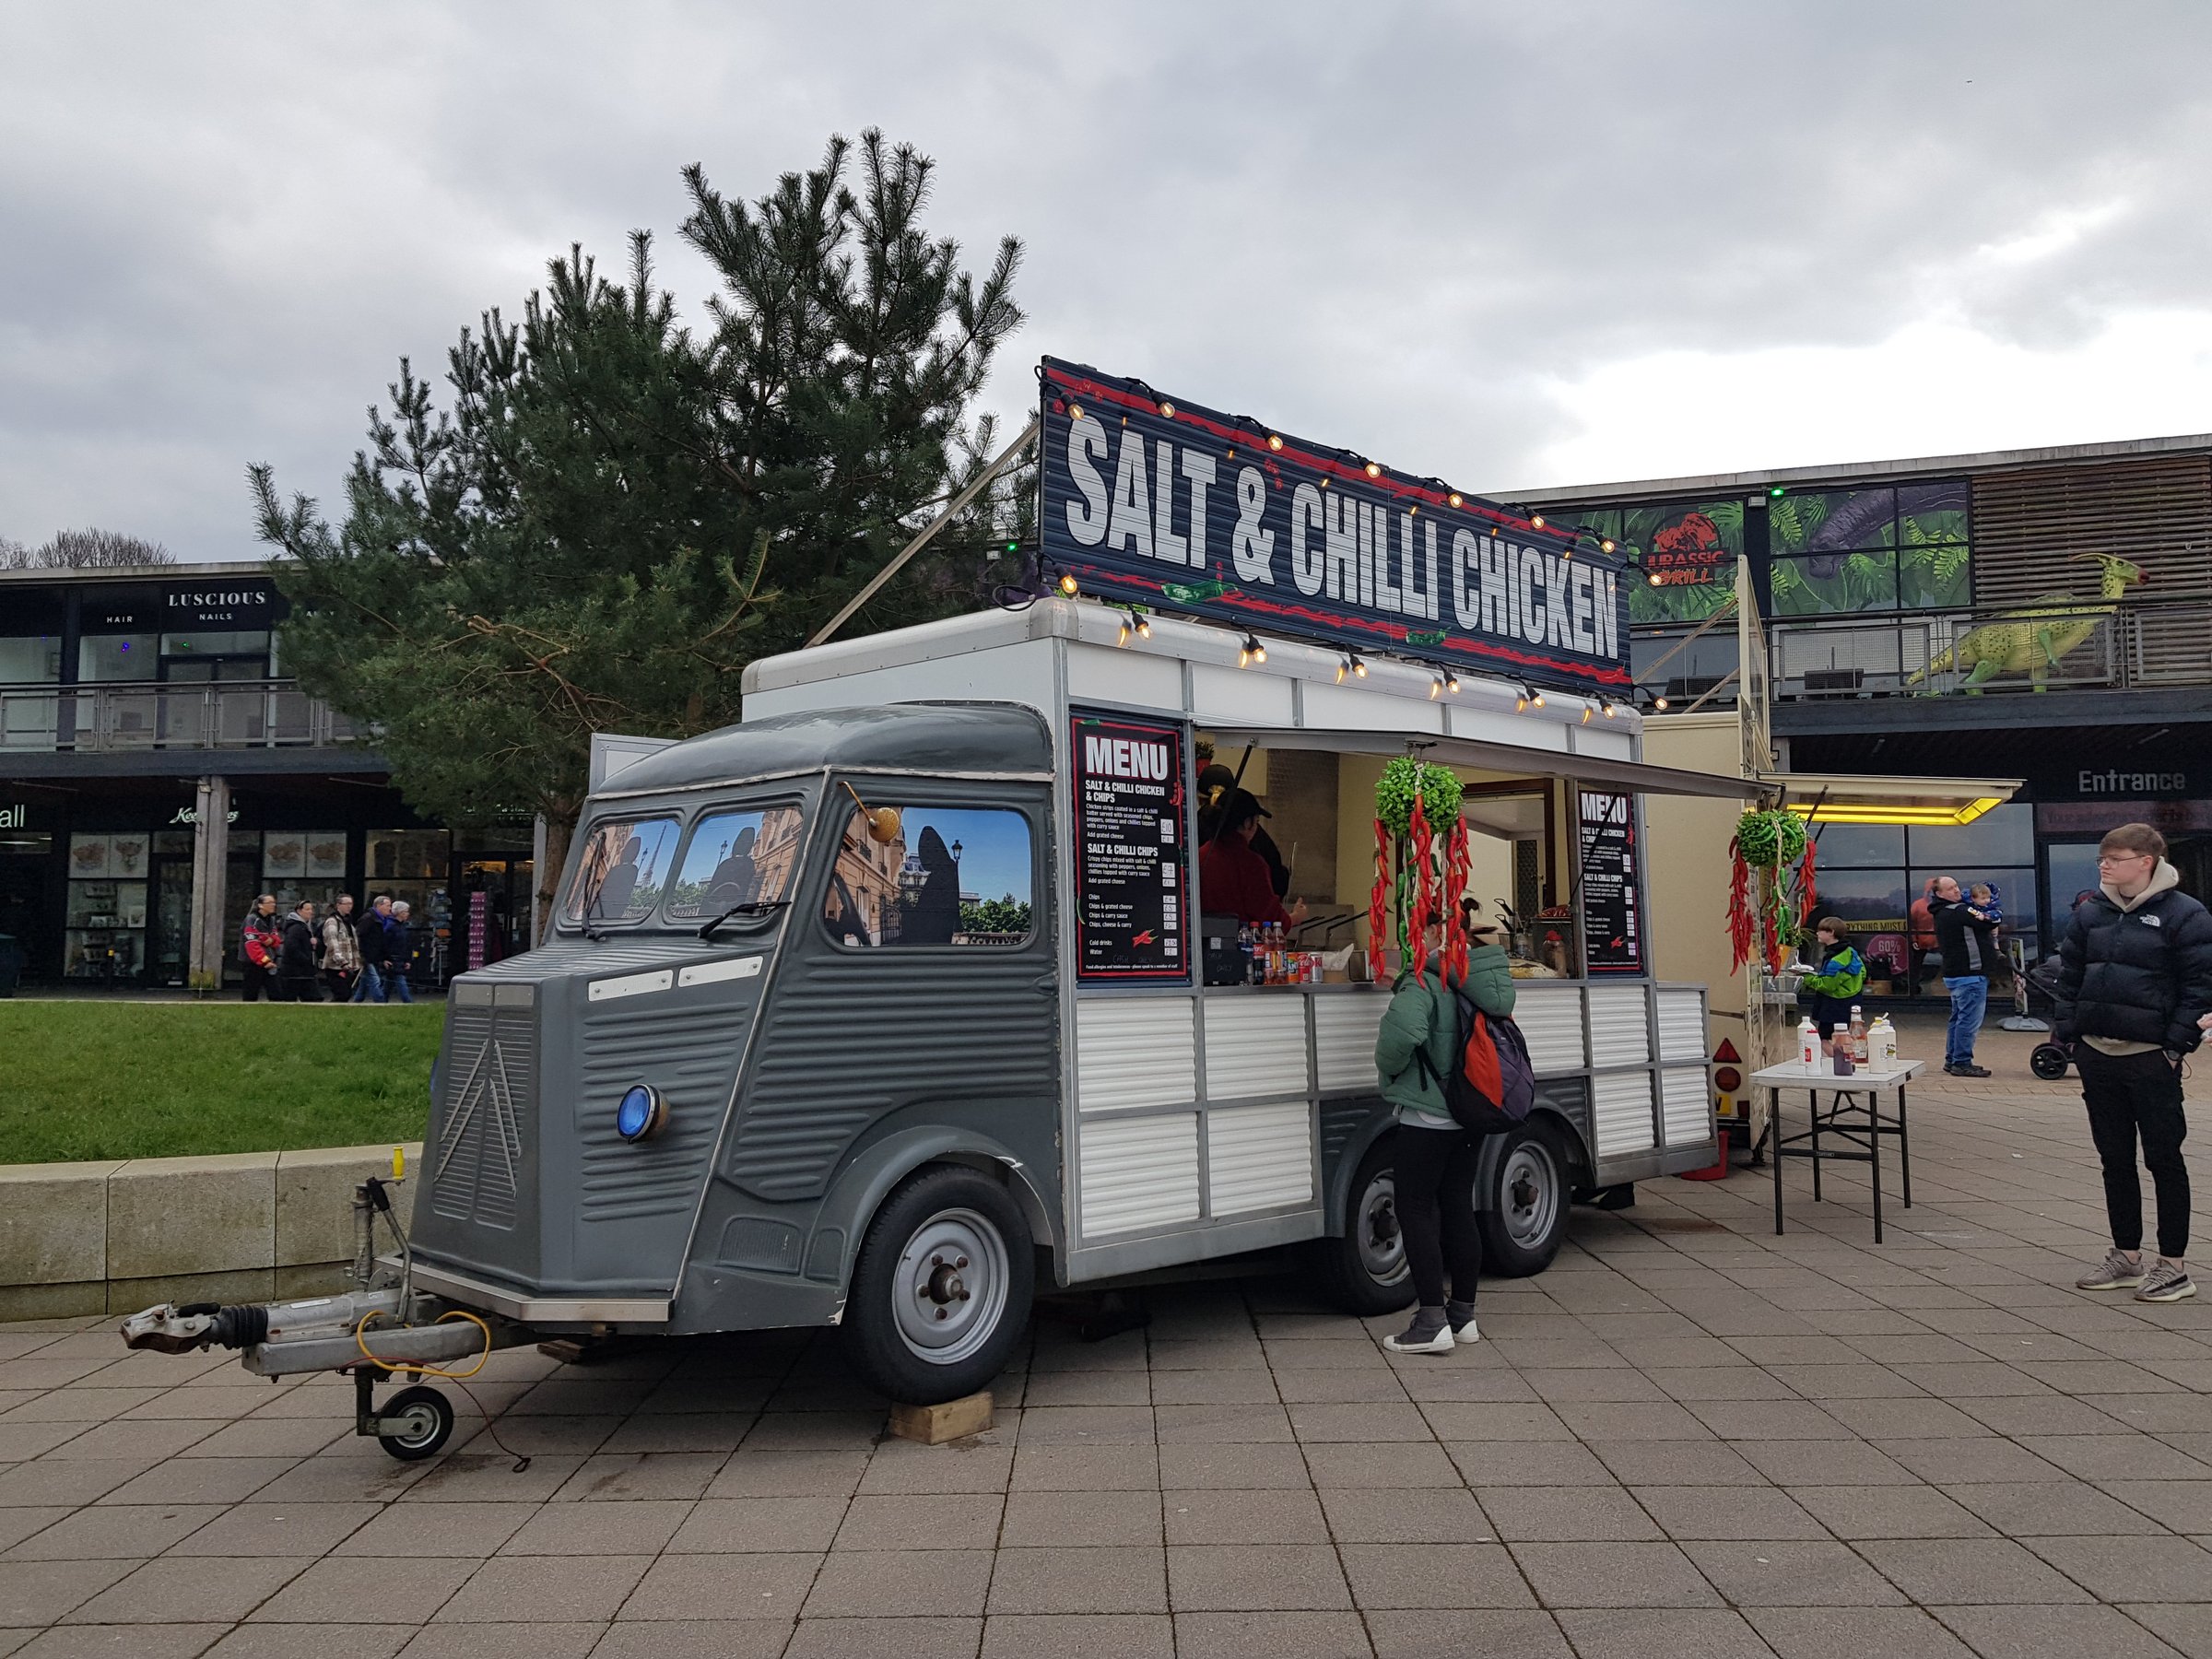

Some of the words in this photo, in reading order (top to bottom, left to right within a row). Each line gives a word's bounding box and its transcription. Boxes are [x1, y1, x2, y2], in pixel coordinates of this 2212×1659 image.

[1065, 414, 1217, 571] SALT
[1230, 465, 1275, 586] &
[1291, 483, 1440, 621] CHILLI
[1453, 529, 1618, 660] CHICKEN
[1657, 568, 1713, 586] GRILL
[169, 592, 265, 606] LUSCIOUS
[1086, 736, 1168, 781] MENU
[1086, 780, 1103, 791] SALT
[1104, 782, 1111, 792] &
[1112, 782, 1134, 794] CHILLI
[1135, 784, 1165, 796] CHICKEN
[2079, 770, 2185, 793] Entrance
[1086, 791, 1092, 801] &
[1093, 792, 1115, 803] CHIPS
[0, 805, 25, 828] all
[169, 806, 239, 823] Keees
[1582, 793, 1627, 823] MENU
[1088, 843, 1105, 854] SALT
[1106, 844, 1112, 855] &
[1114, 845, 1135, 856] CHILLI
[1137, 846, 1158, 858] CHIPS
[1880, 922, 1900, 931] MUST
[1878, 940, 1900, 952] 60%
